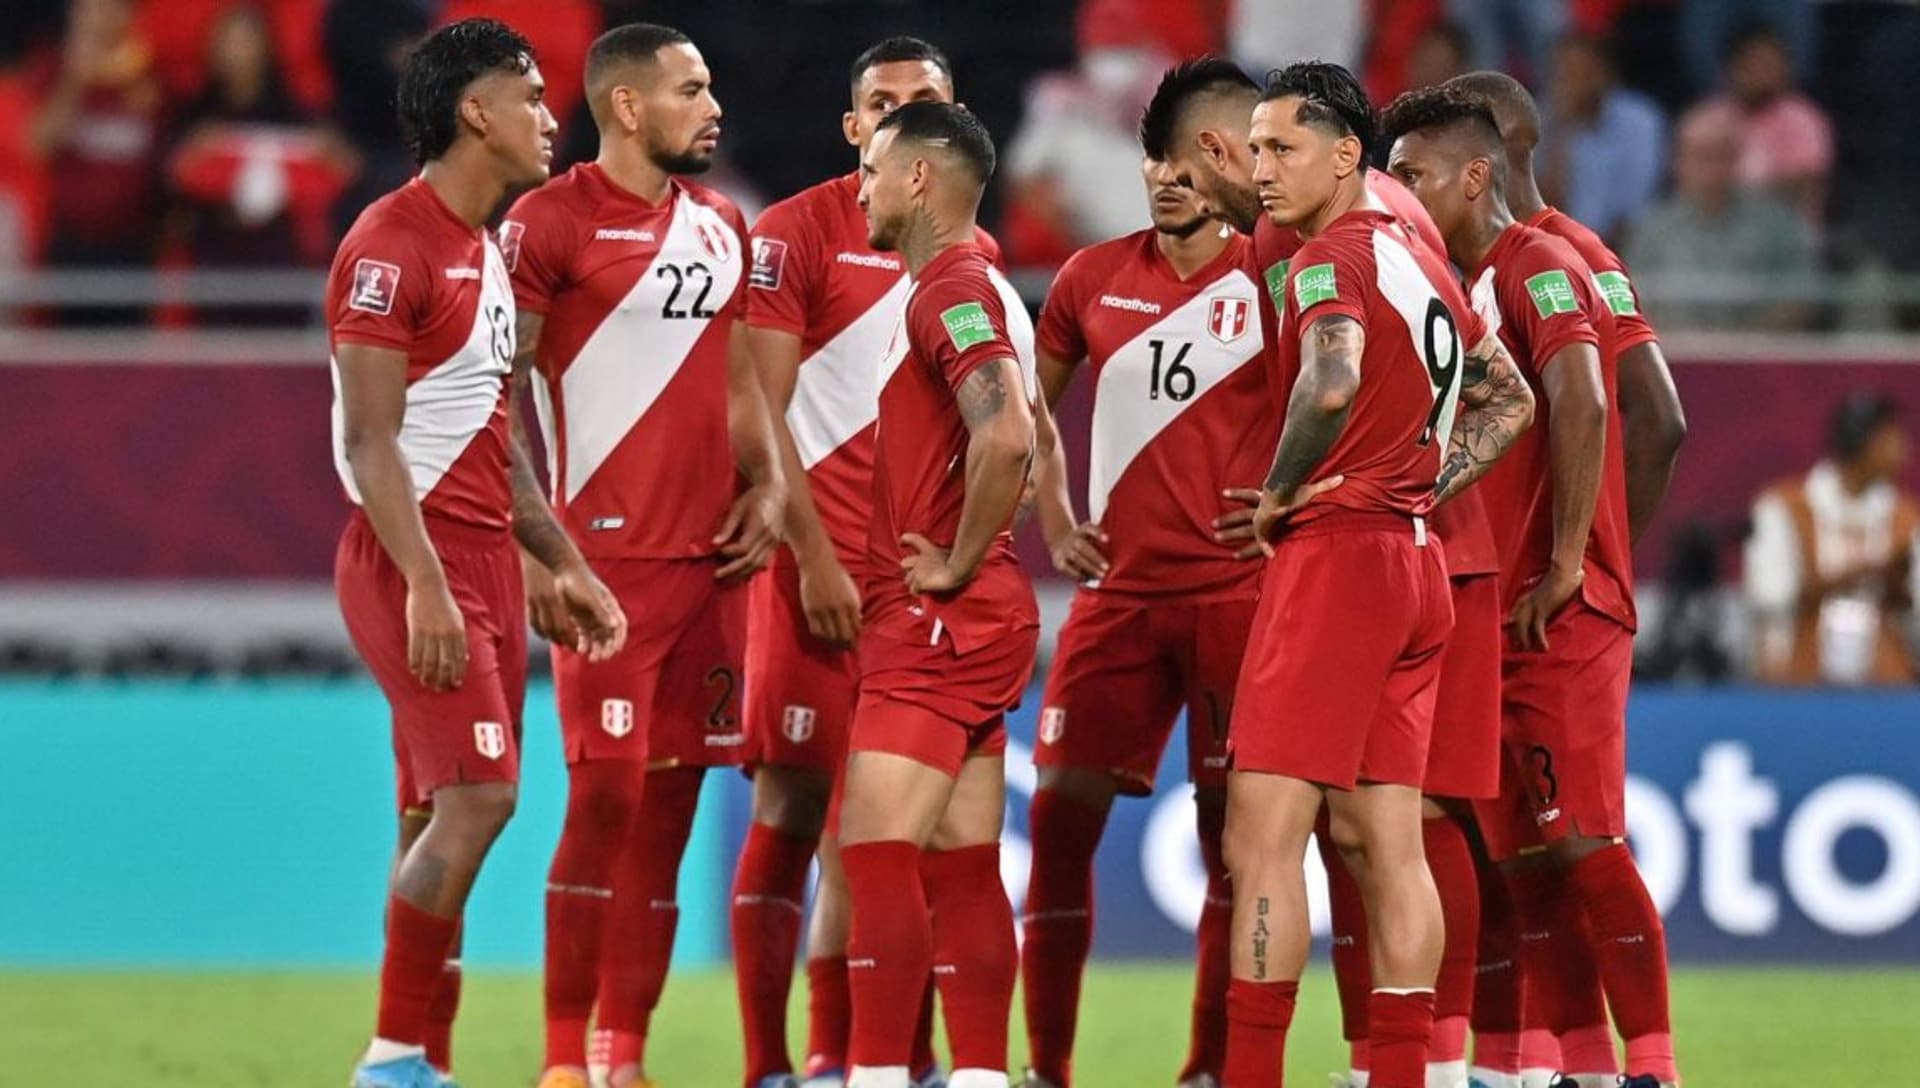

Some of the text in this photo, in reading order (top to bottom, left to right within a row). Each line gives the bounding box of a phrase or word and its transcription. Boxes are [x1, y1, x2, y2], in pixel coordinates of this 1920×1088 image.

[595, 229, 656, 243] marathon
[837, 252, 900, 271] marathon
[657, 262, 716, 319] 22
[484, 304, 513, 367] 13
[1149, 339, 1197, 402] 16
[1417, 296, 1458, 448] 9
